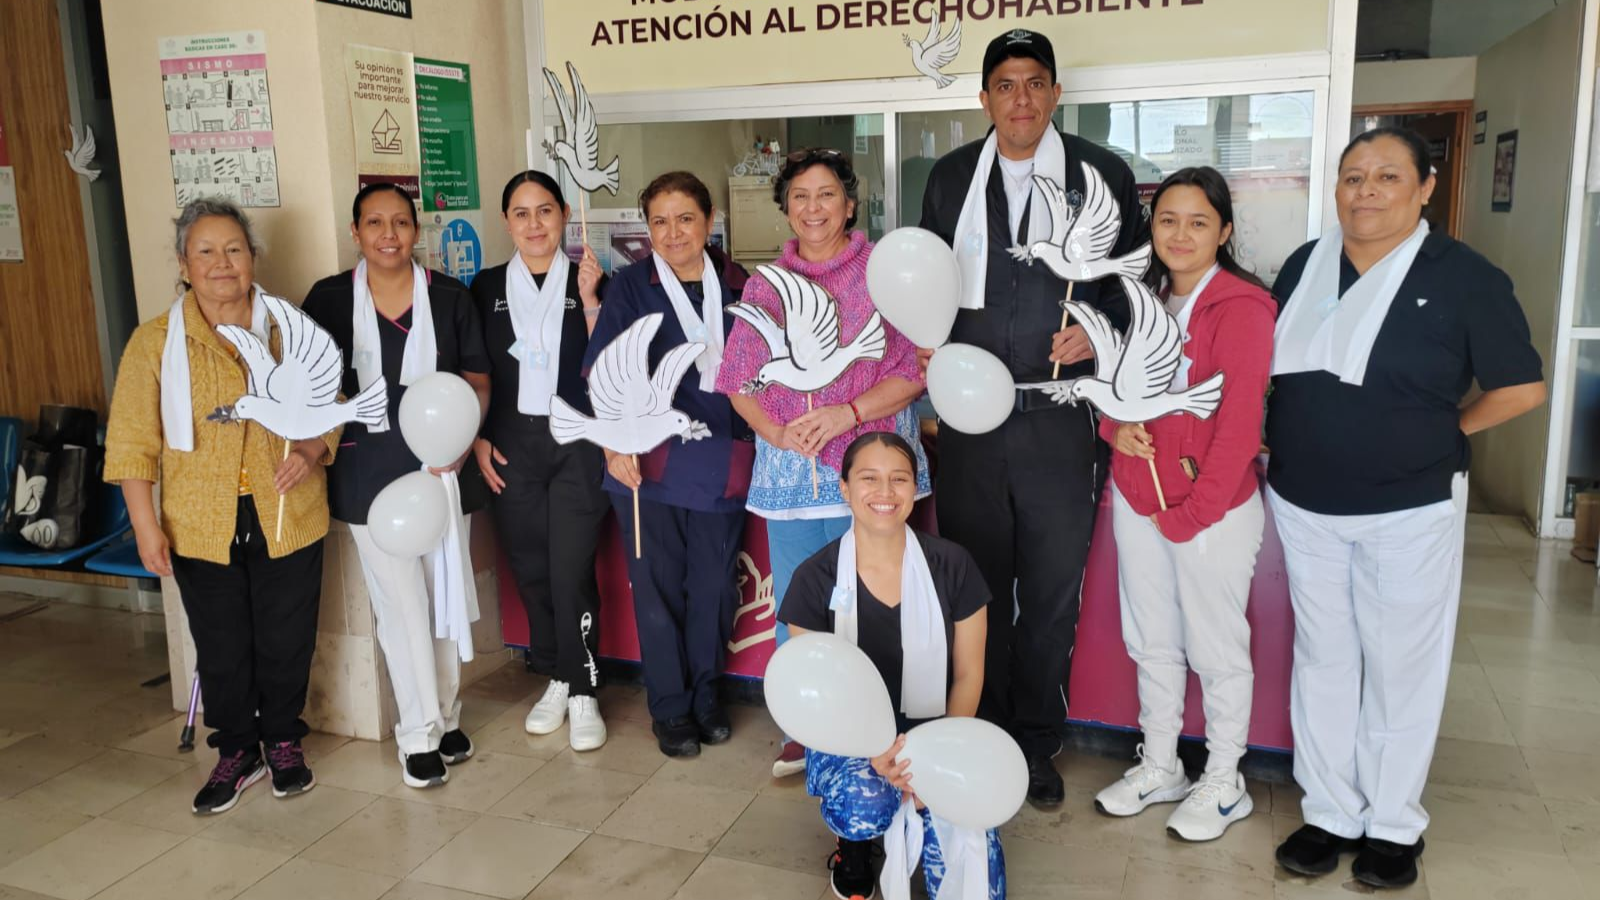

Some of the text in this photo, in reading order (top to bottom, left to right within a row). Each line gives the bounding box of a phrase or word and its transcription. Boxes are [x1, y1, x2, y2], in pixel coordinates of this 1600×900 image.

[339, 0, 407, 14] CUACIÓN
[591, 0, 1205, 46] ATENCIÓN AL DERECHOHABI
[187, 59, 233, 69] SISMO
[354, 60, 365, 70] Su
[366, 62, 396, 75] opinión
[360, 70, 401, 84] importante
[358, 82, 404, 94] para mejorar
[354, 91, 410, 104] nuestro servicio
[183, 135, 255, 146] INCENDIO
